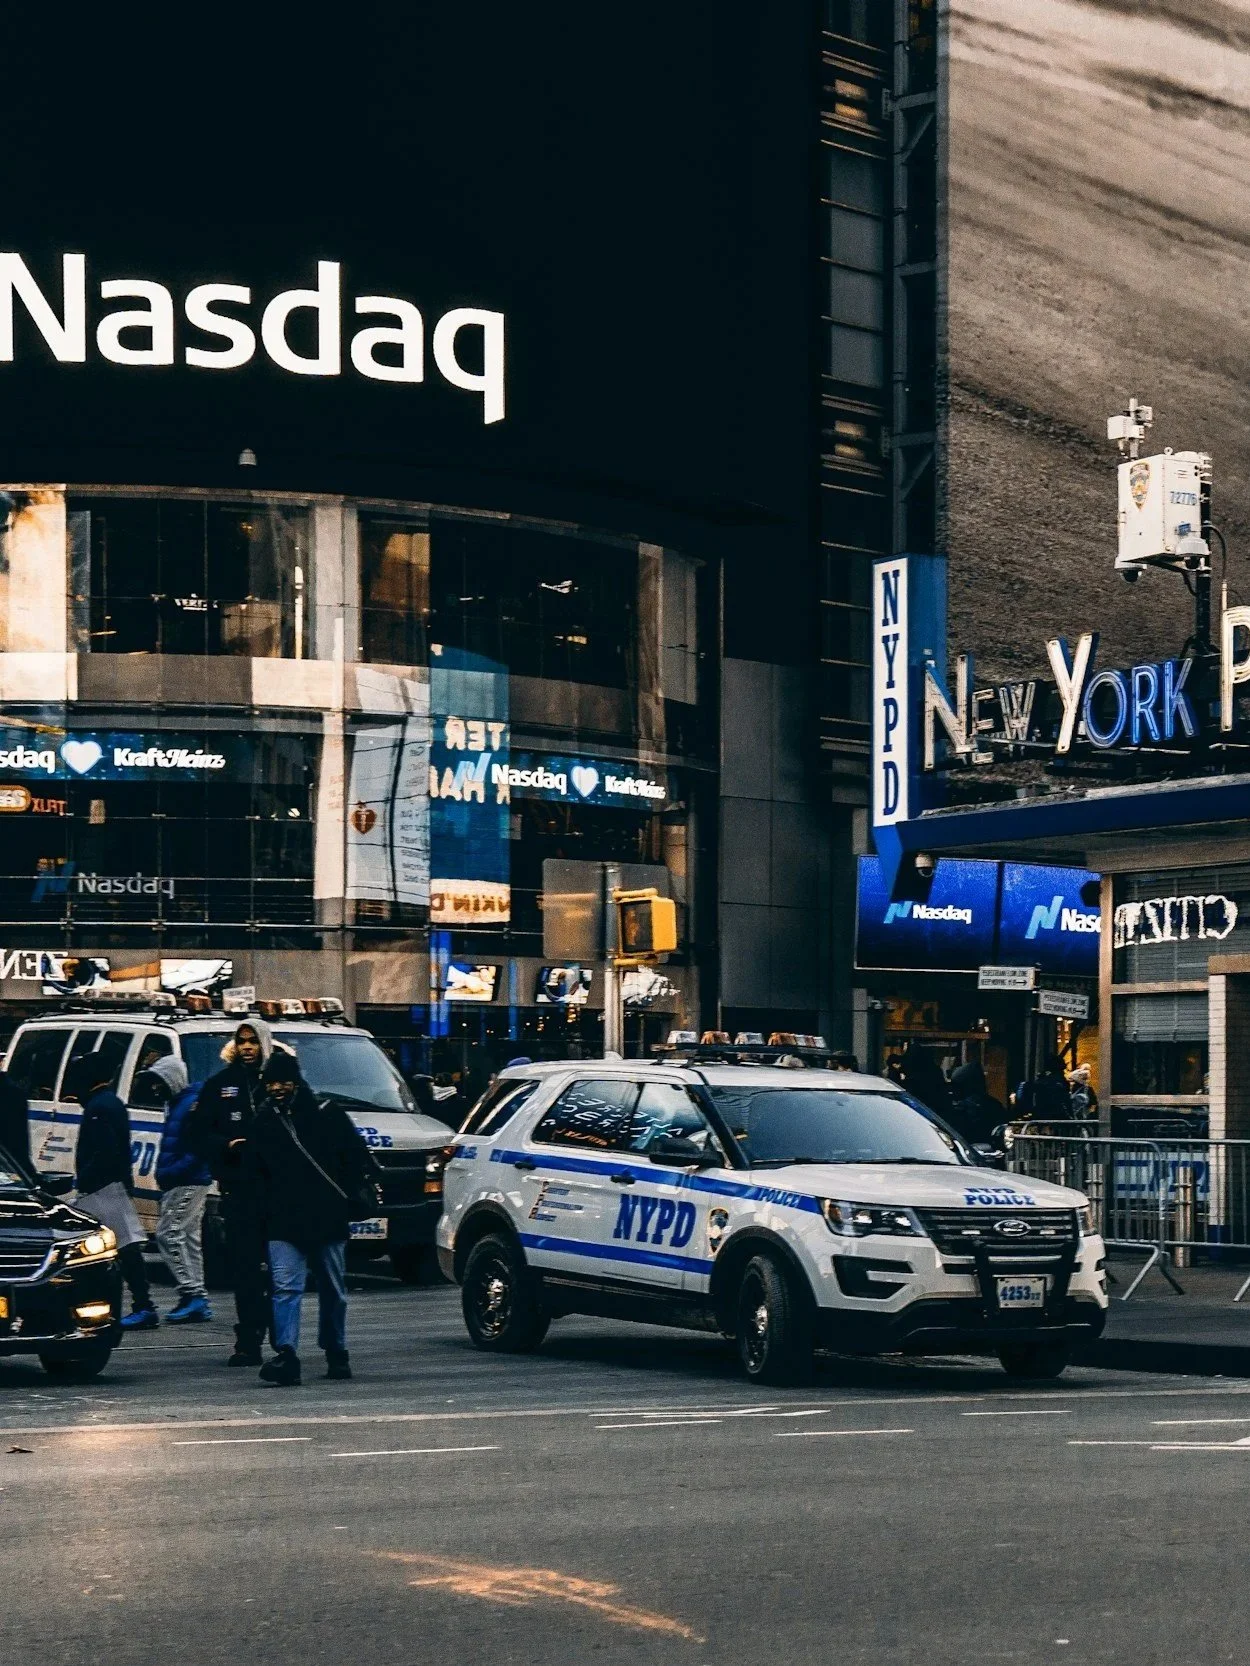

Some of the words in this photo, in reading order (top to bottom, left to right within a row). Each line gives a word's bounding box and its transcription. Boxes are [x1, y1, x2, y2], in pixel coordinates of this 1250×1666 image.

[0, 252, 506, 425] Nasdaq
[881, 569, 900, 816] NYPD
[491, 763, 568, 796] Nasdaq
[77, 872, 175, 899] Nasdaq
[911, 903, 973, 925] Nasdaq
[758, 1186, 801, 1208] POLICE
[963, 1193, 1037, 1205] POLICE
[612, 1193, 697, 1248] NYPD
[1000, 1285, 1031, 1301] 4253
